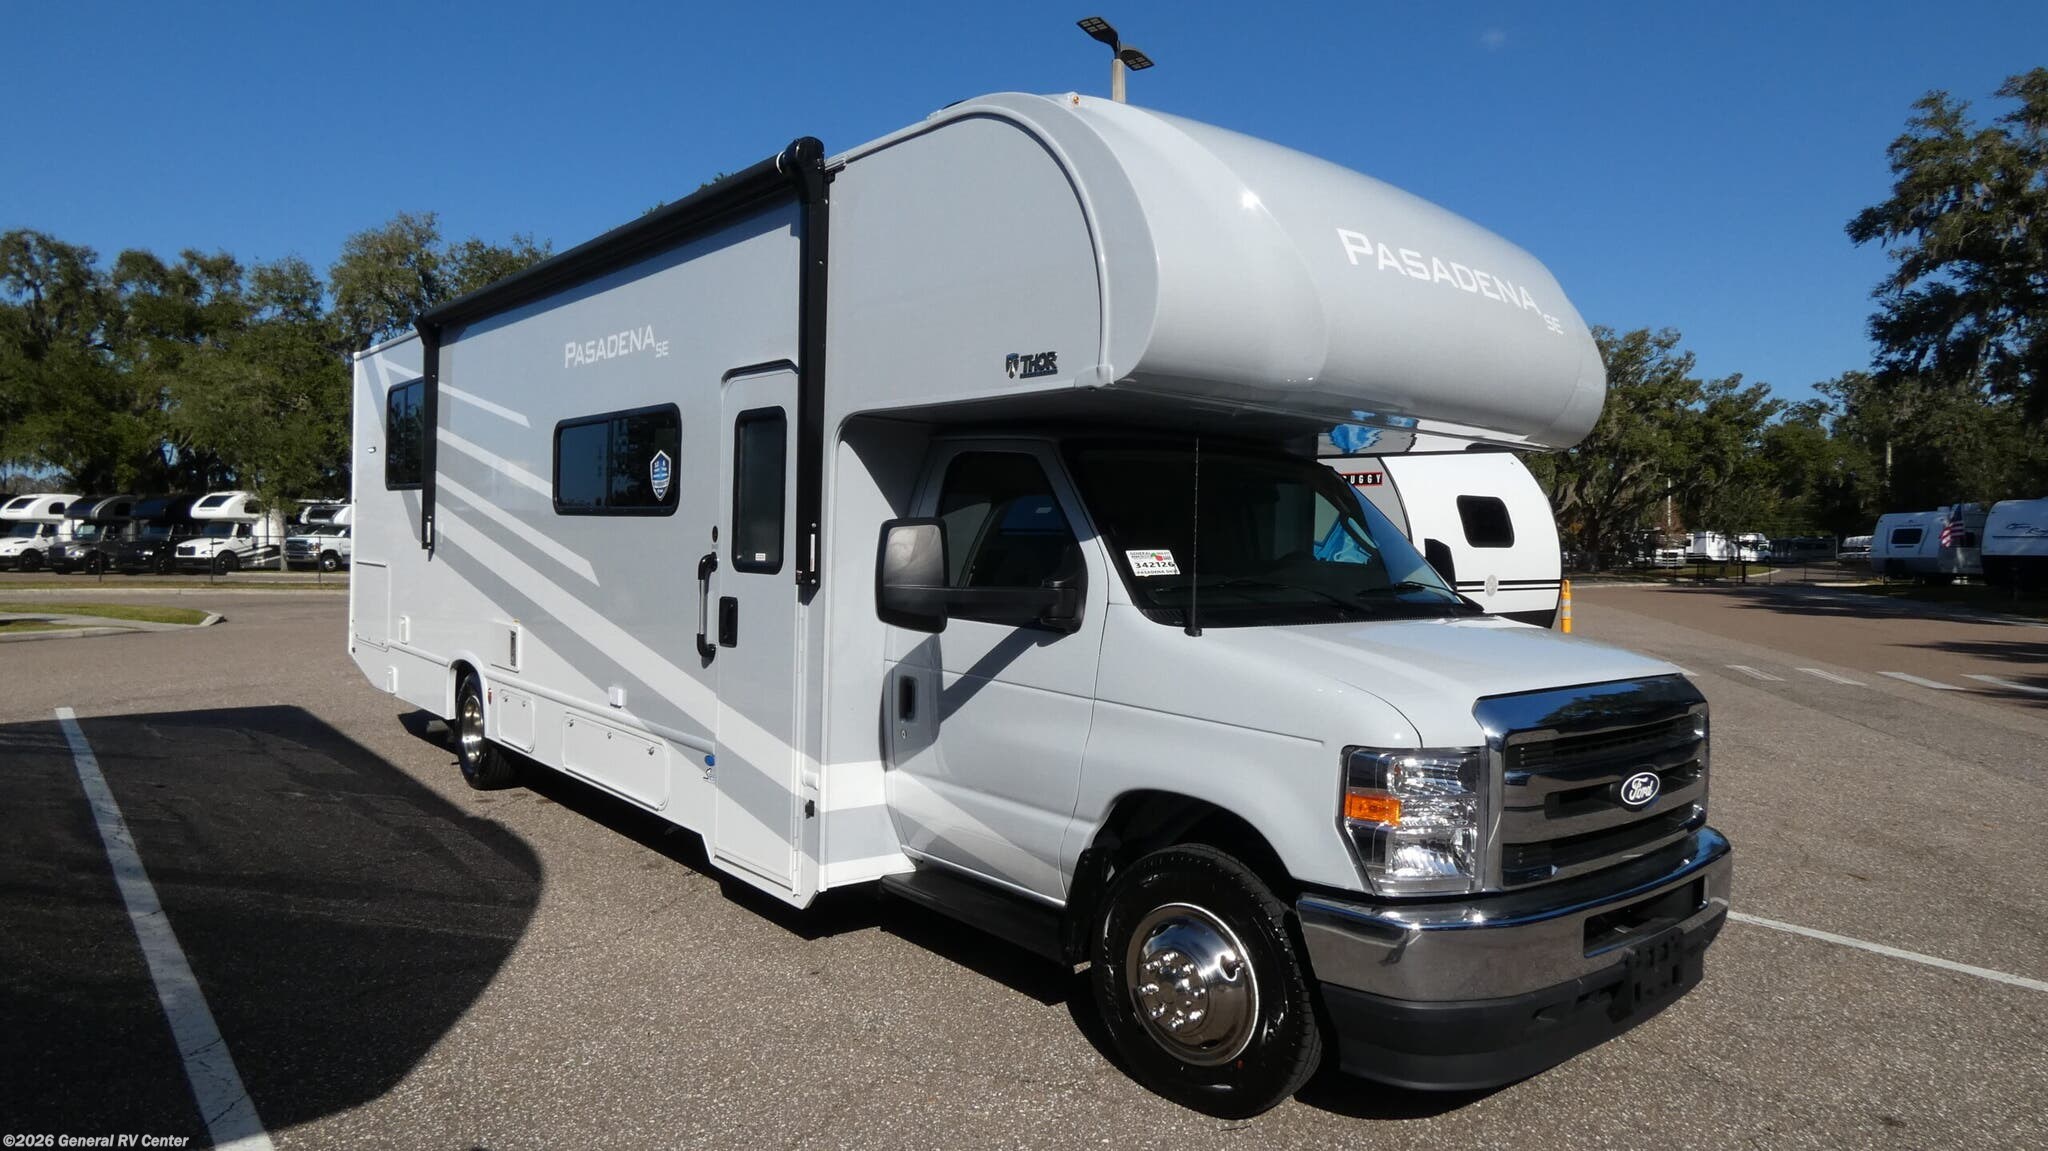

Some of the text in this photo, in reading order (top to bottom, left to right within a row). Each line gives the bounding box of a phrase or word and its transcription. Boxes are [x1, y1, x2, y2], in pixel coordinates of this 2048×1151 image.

[1336, 228, 1564, 335] PASADENA SE
[565, 325, 669, 368] PASADENA SE
[1020, 351, 1058, 374] THOR
[1629, 777, 1654, 800] Ford
